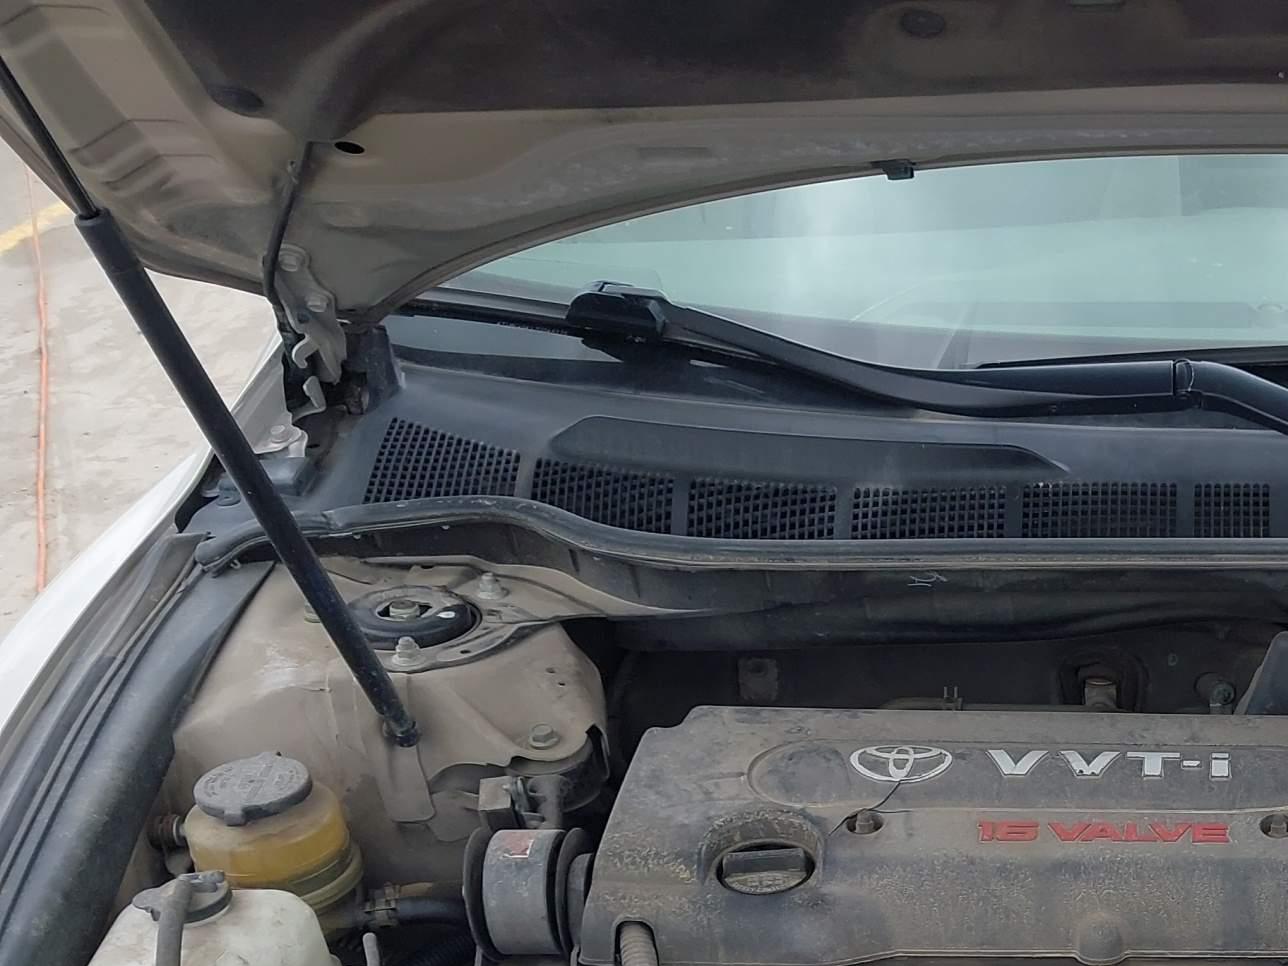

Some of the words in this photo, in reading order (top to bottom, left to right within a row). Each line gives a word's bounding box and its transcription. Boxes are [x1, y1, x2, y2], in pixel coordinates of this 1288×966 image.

[985, 749, 1232, 779] VVT-i
[977, 820, 1040, 842] 16
[1047, 820, 1232, 844] VALVE
